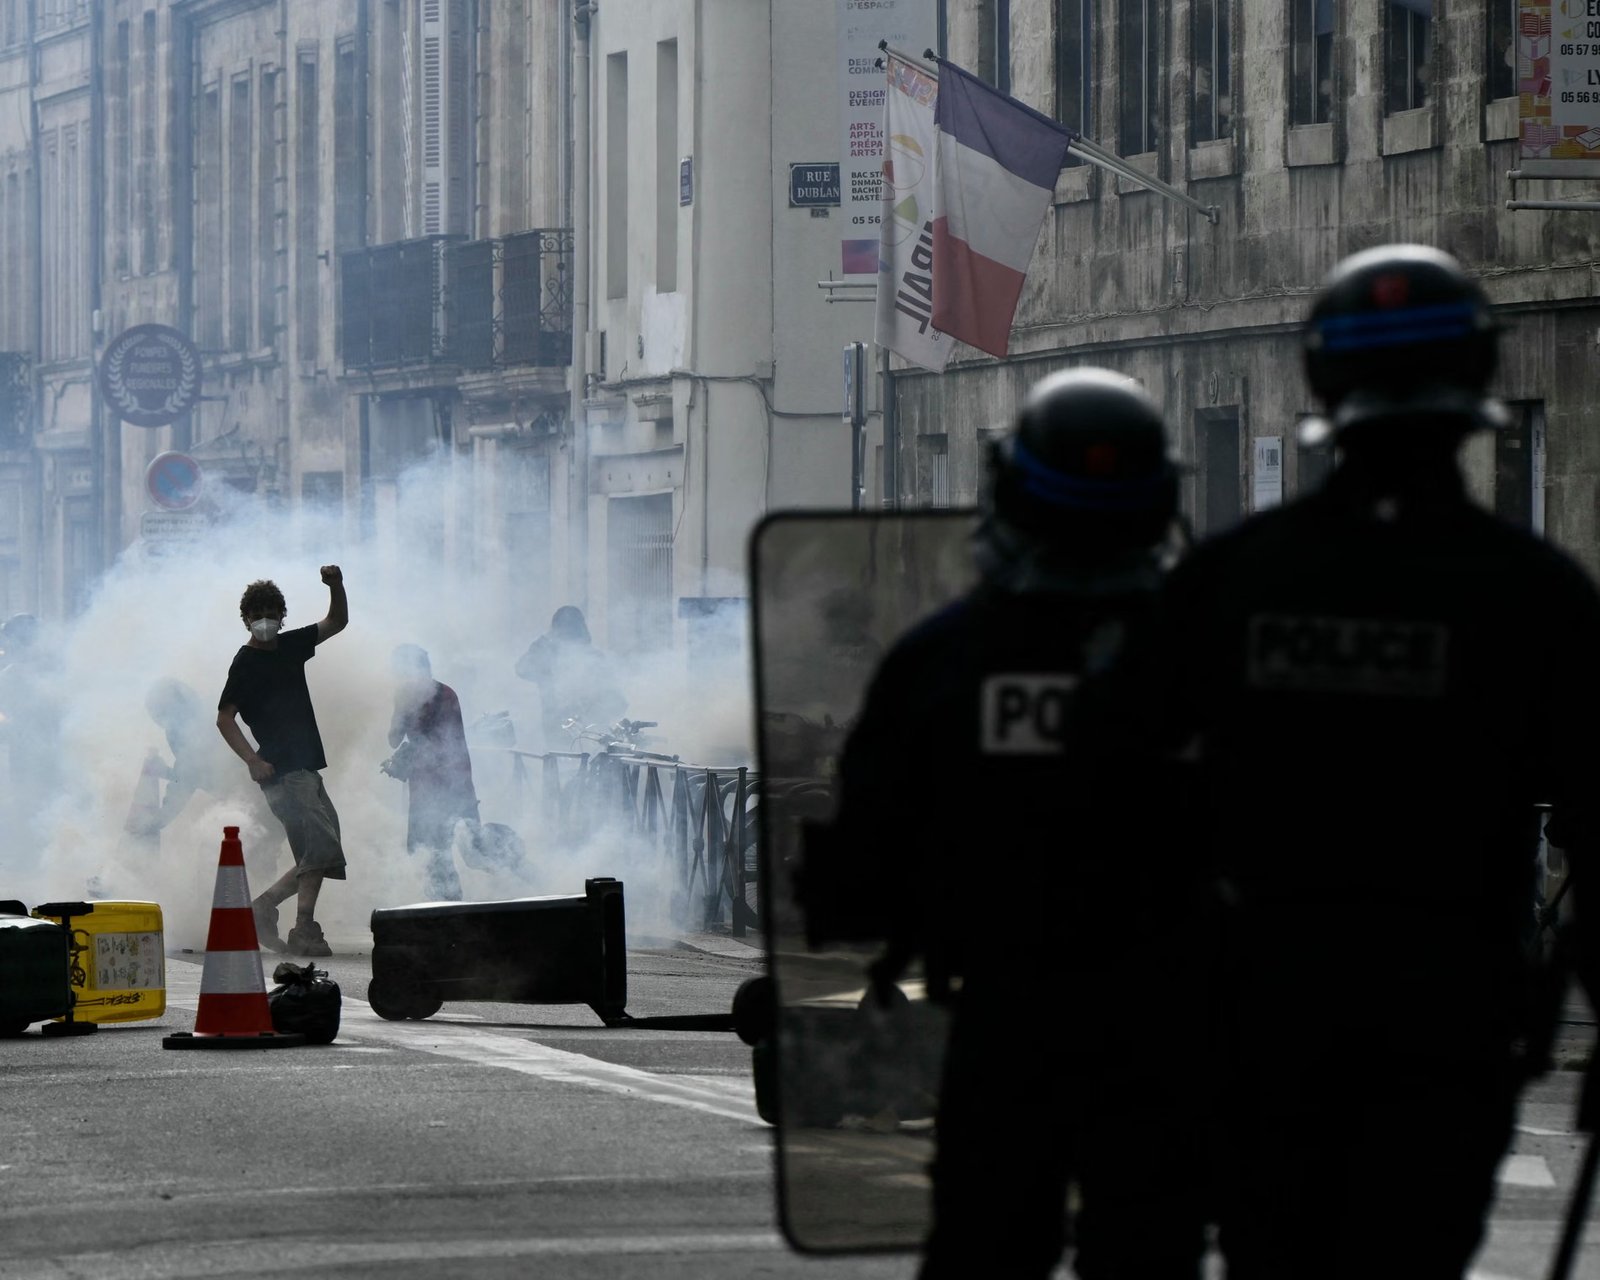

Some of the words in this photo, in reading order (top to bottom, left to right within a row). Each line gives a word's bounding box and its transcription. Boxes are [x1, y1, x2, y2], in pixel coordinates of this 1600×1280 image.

[1561, 44, 1574, 55] 05
[1576, 44, 1589, 55] 57
[1561, 91, 1574, 103] 05
[1577, 91, 1590, 103] 56
[850, 122, 876, 130] ARTS
[850, 149, 877, 157] ARTS
[806, 171, 830, 182] RUE
[851, 171, 868, 179] BAC
[797, 187, 840, 198] DUBLAN
[852, 216, 865, 225] 05
[867, 216, 881, 224] 56
